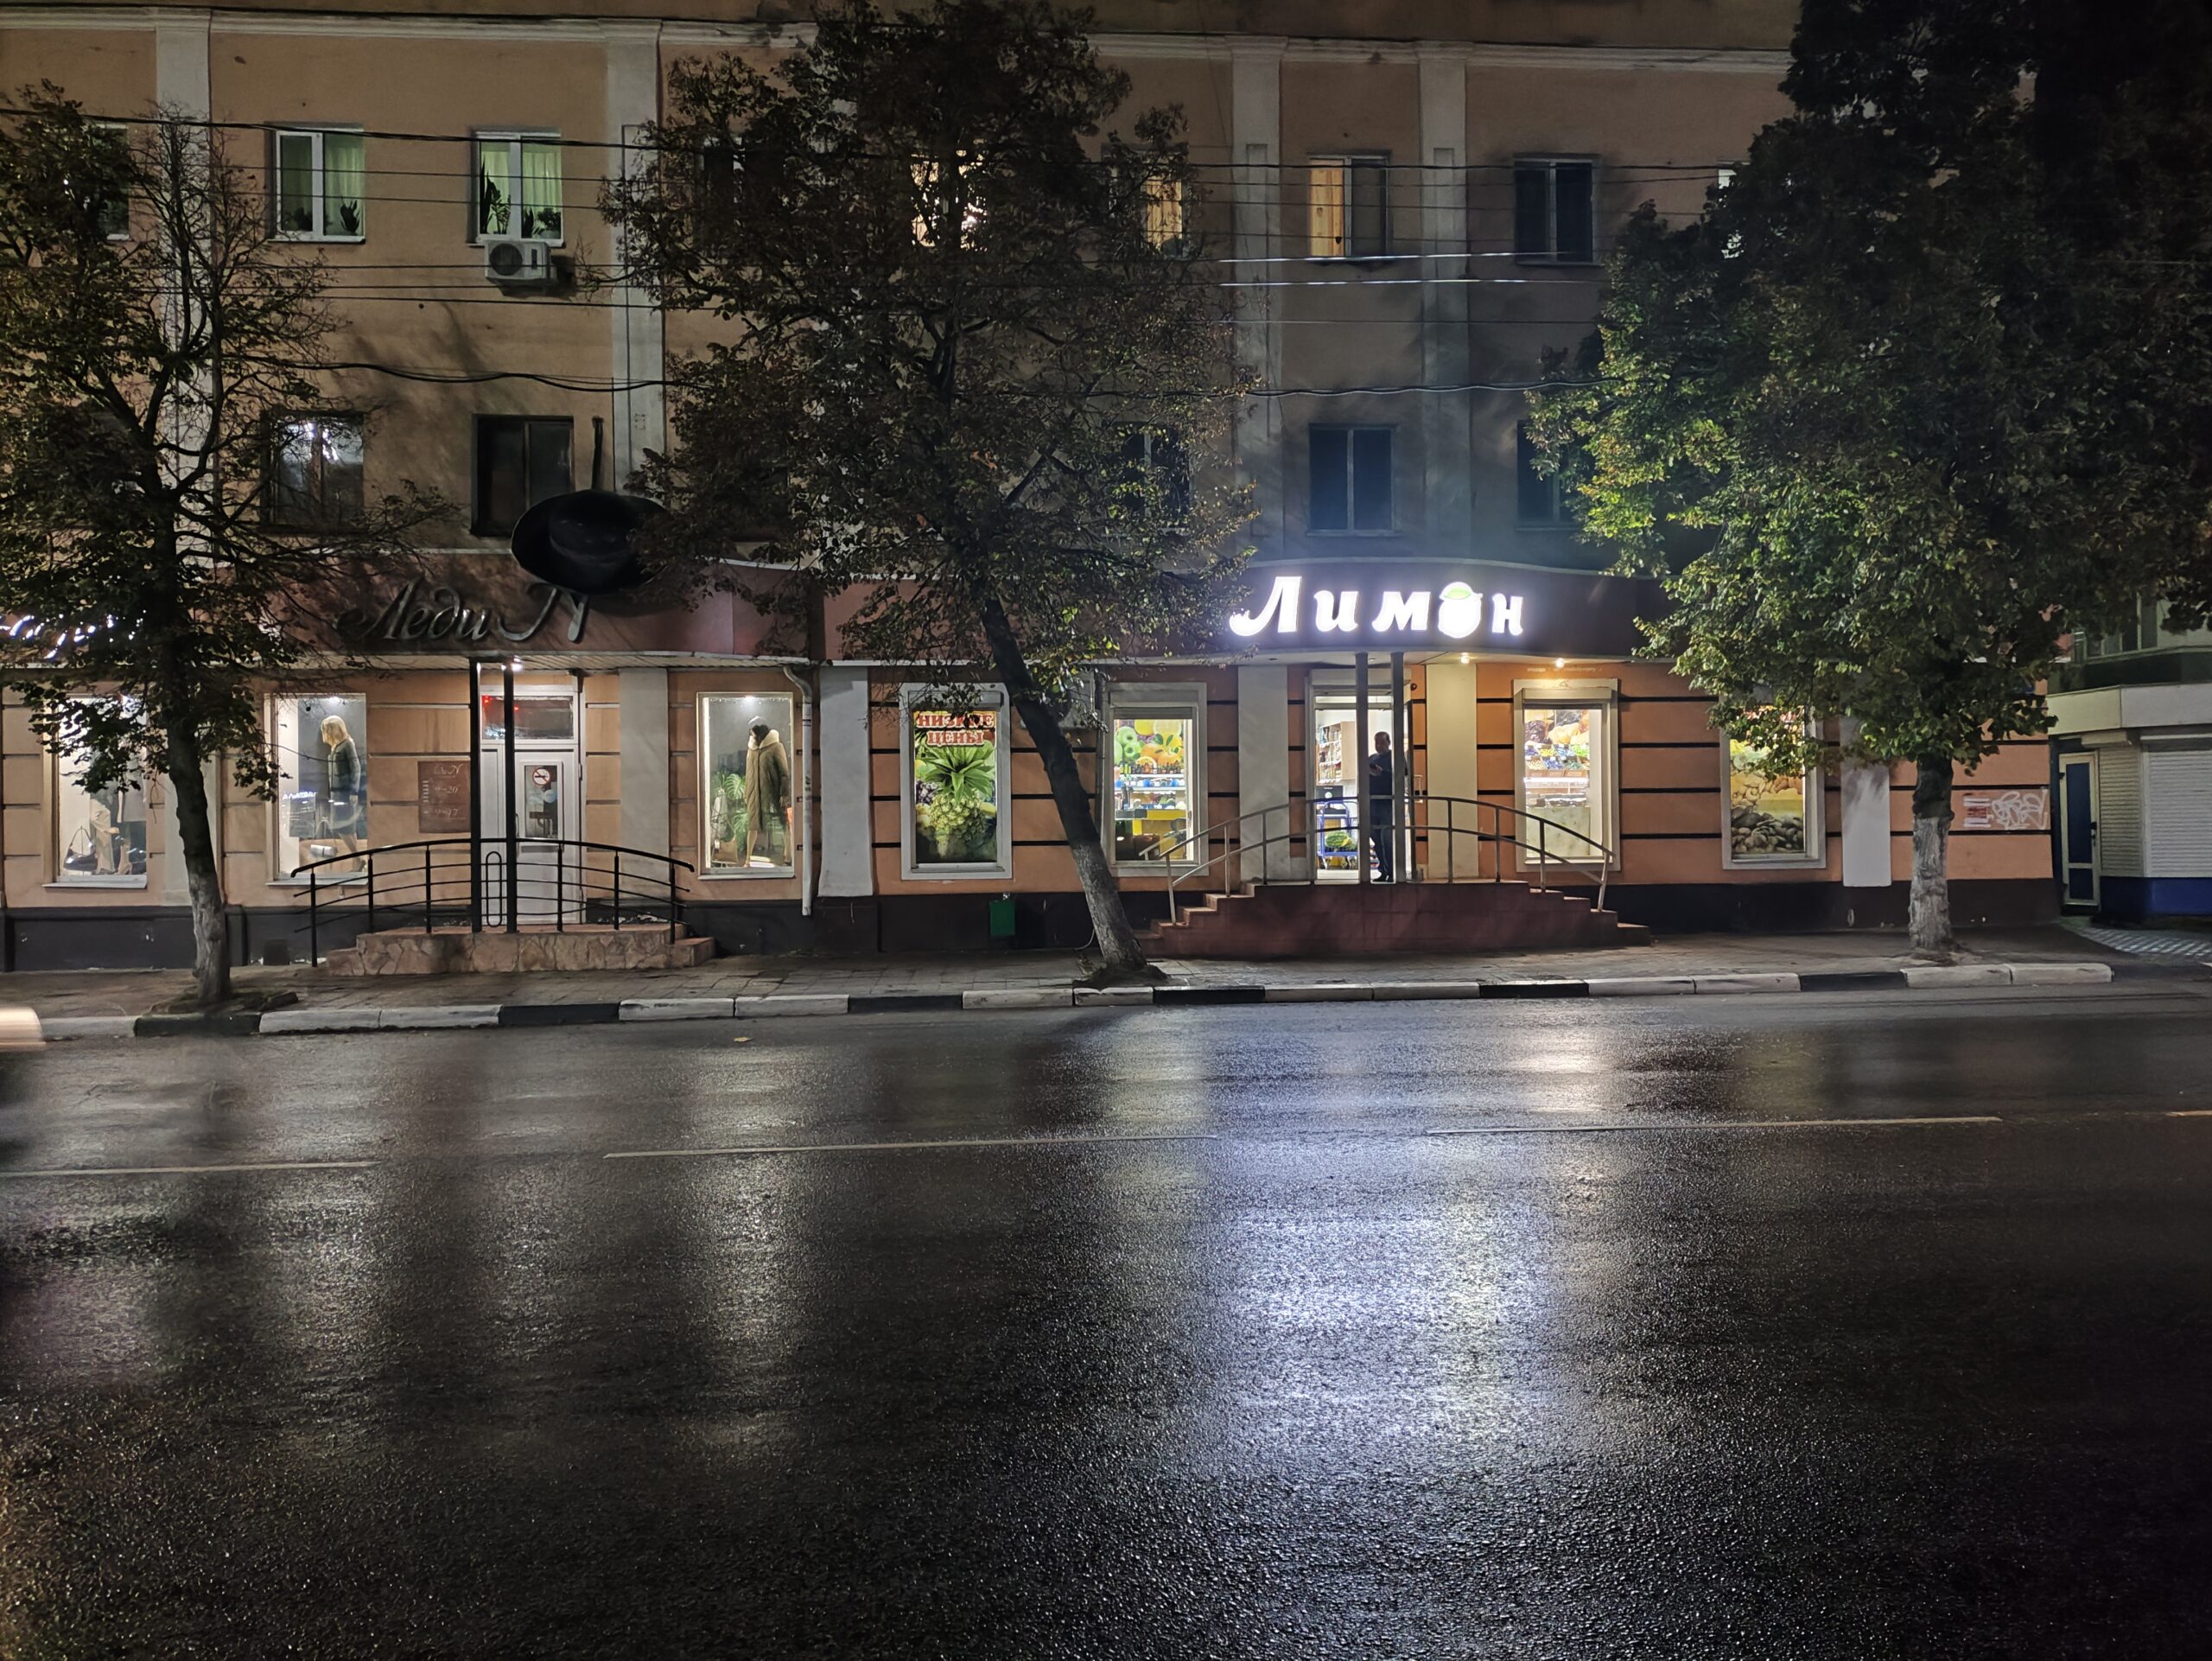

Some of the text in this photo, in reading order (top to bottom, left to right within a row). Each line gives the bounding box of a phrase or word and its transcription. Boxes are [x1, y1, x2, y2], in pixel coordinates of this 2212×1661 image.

[334, 576, 492, 641] Леди
[1229, 576, 1524, 639] Лимон
[927, 731, 984, 747] ЦЕНЫ
